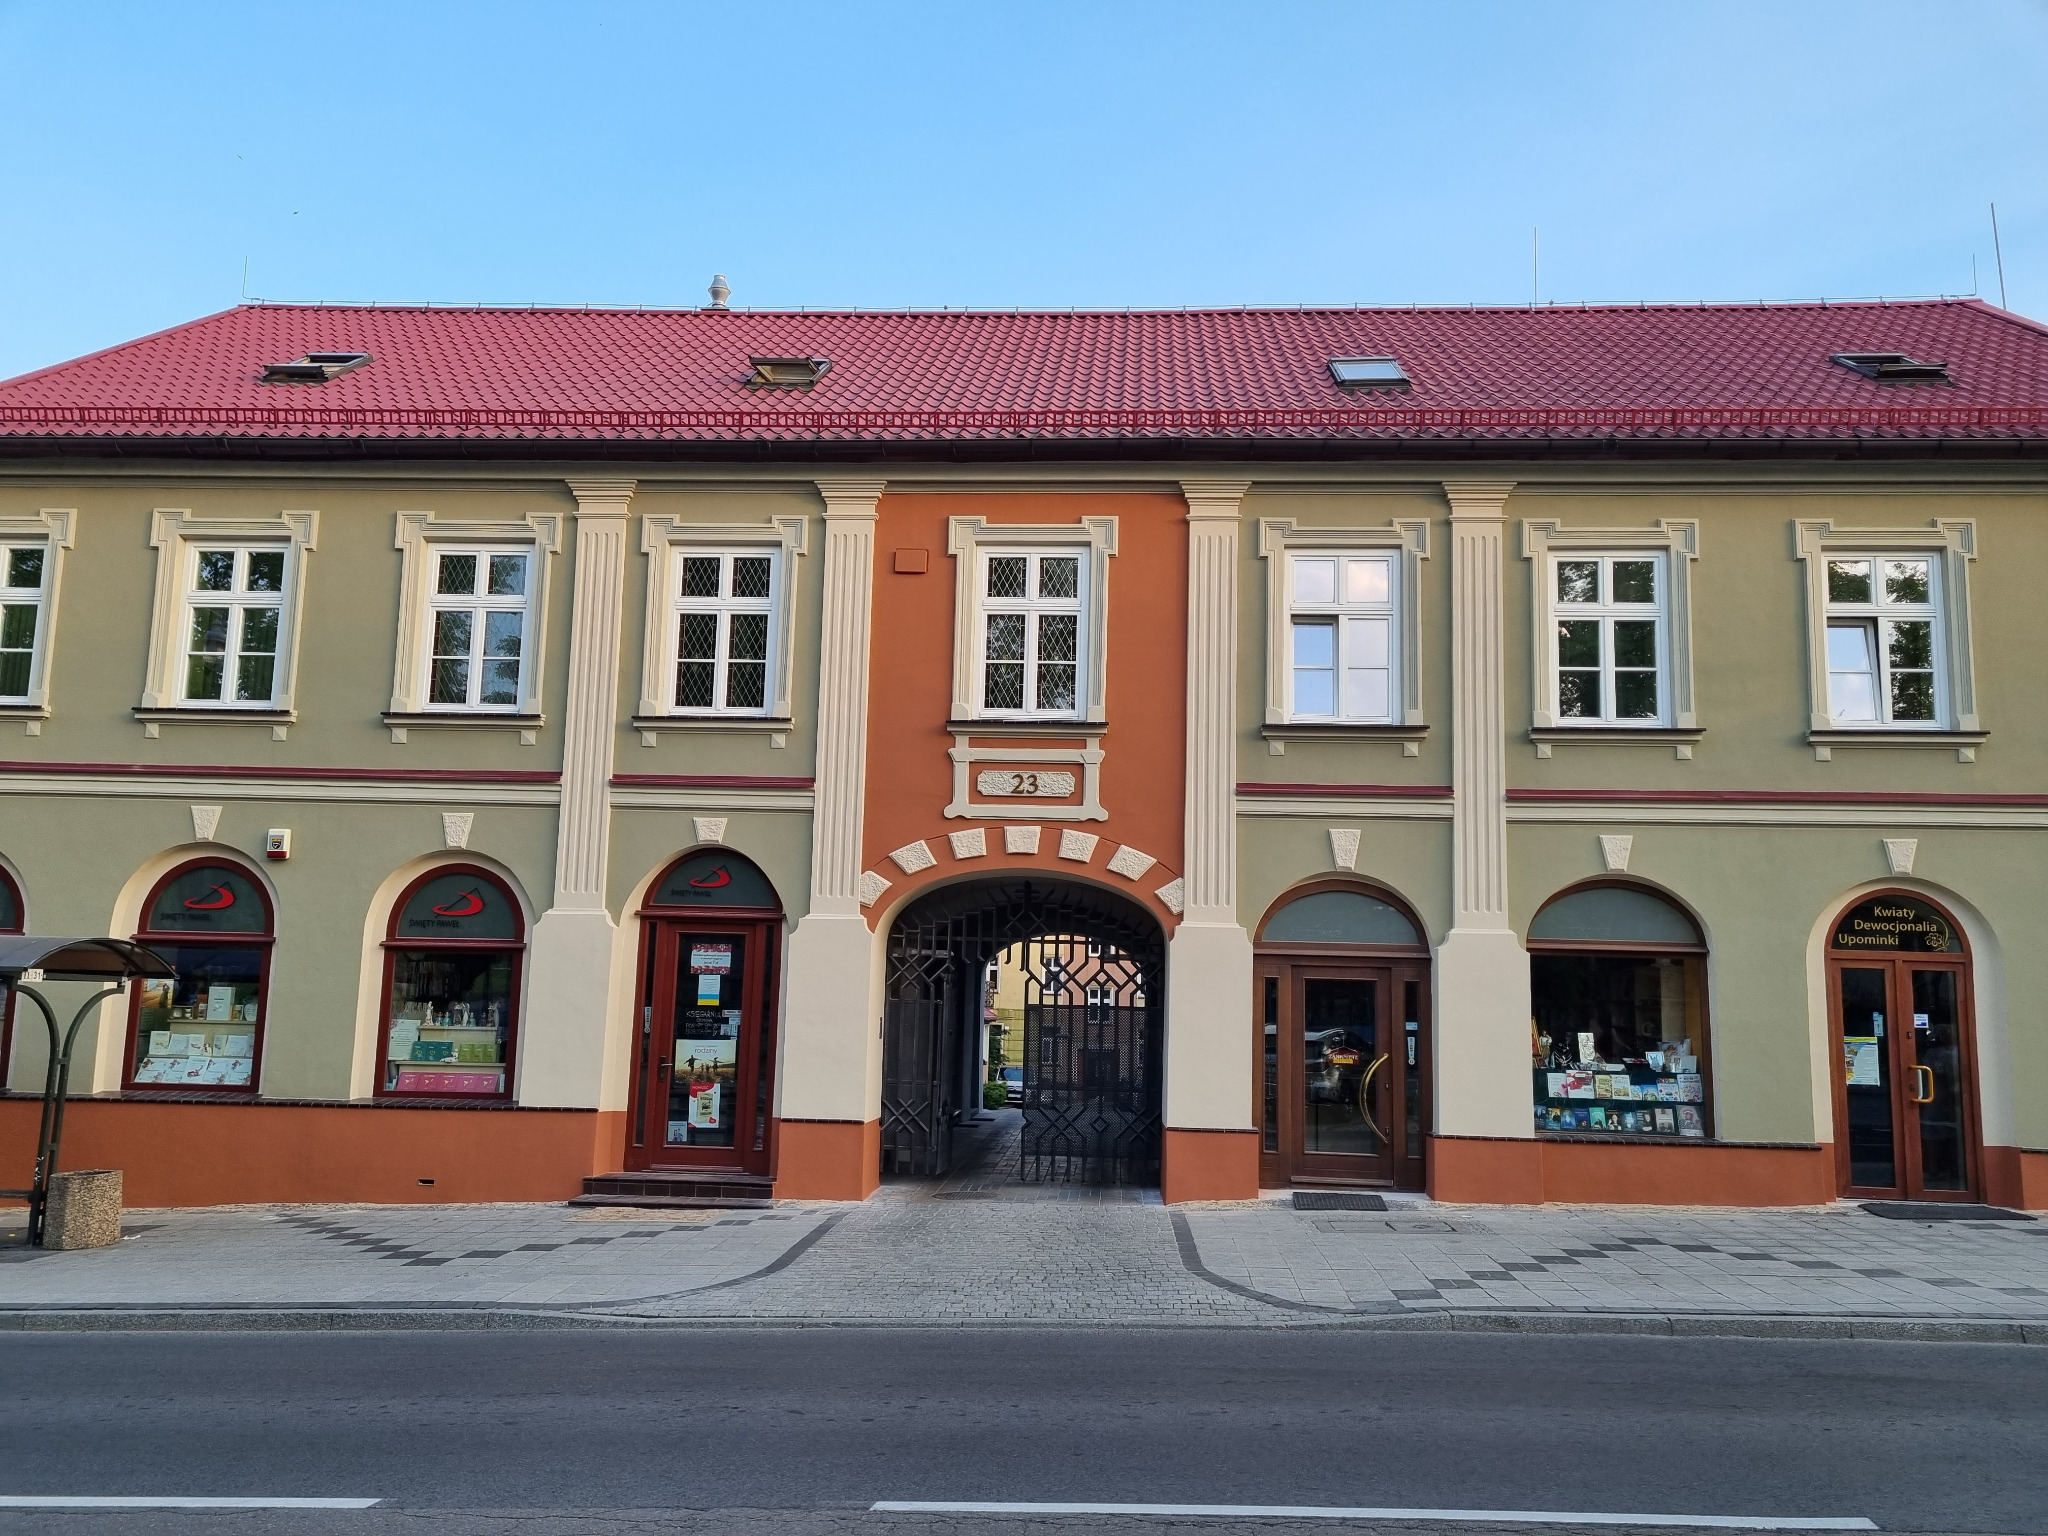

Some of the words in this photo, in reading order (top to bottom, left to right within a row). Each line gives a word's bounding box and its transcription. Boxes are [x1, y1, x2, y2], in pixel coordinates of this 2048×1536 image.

[1011, 773, 1039, 795] 23
[1874, 906, 1915, 920] Kwiaty
[408, 917, 436, 929] ŚWIĘTY
[436, 919, 460, 928] PAWEŁ
[1854, 919, 1938, 934] Dewocjonalia
[1838, 933, 1899, 947] Upominki
